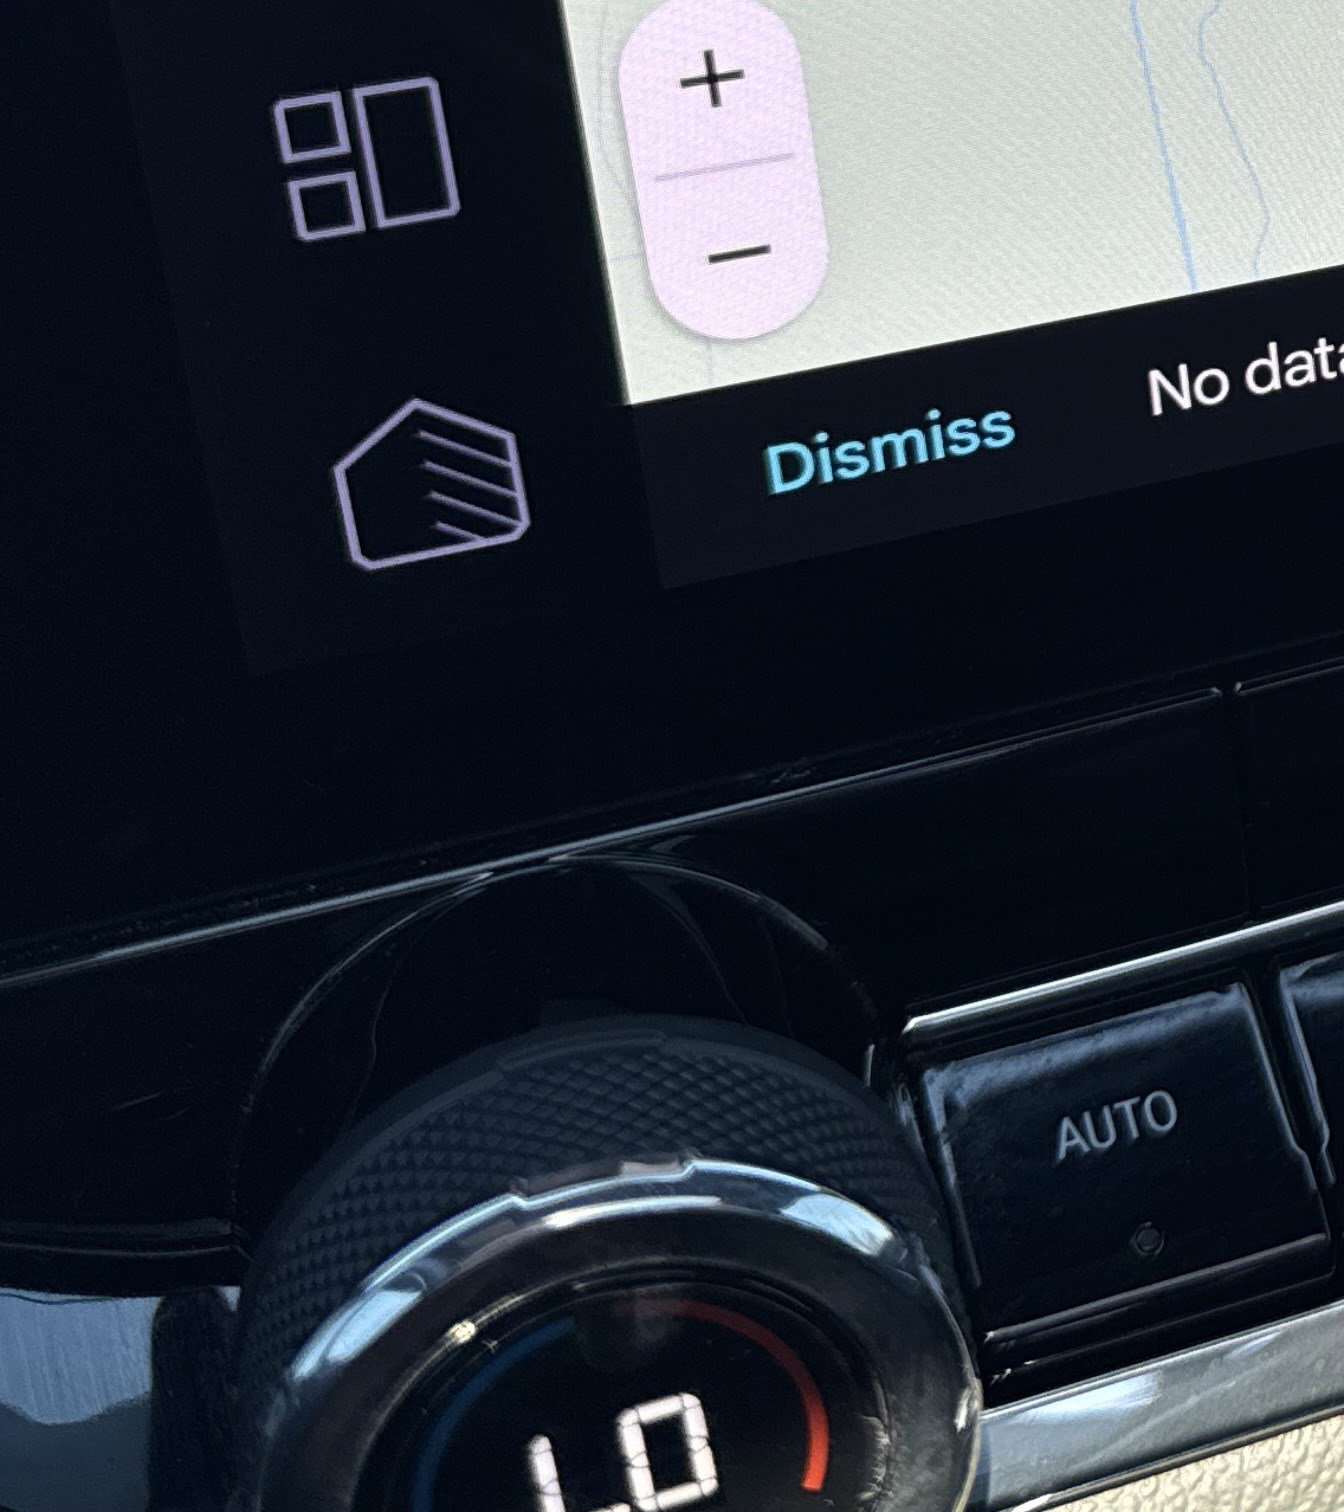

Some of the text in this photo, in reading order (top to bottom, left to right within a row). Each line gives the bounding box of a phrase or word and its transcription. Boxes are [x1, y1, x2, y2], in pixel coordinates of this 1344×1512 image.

[1147, 364, 1231, 416] No
[764, 406, 1017, 497] Dismiss
[1054, 1090, 1179, 1162] AUTO
